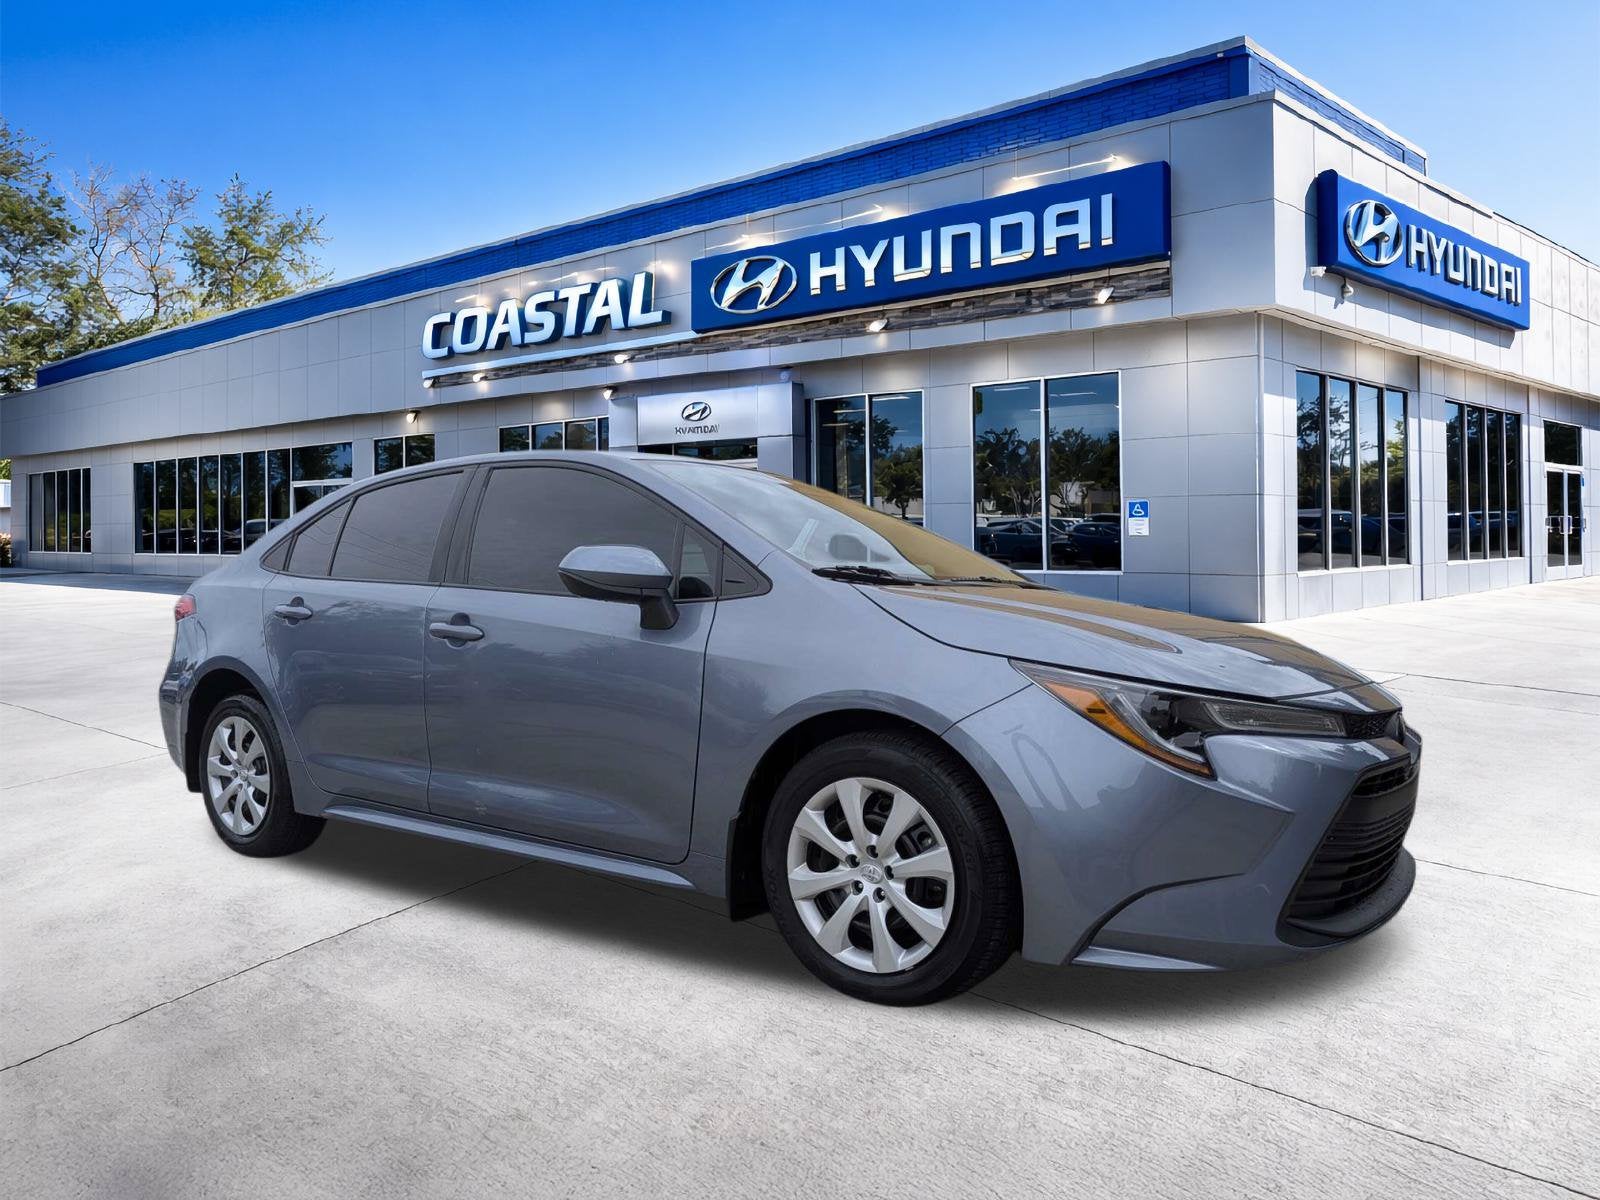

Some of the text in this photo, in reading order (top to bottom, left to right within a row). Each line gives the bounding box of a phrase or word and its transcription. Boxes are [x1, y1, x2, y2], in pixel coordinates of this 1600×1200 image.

[809, 193, 1113, 295] HYUNDAI
[1406, 224, 1522, 305] HYUNDAI
[422, 271, 668, 359] COASTAL
